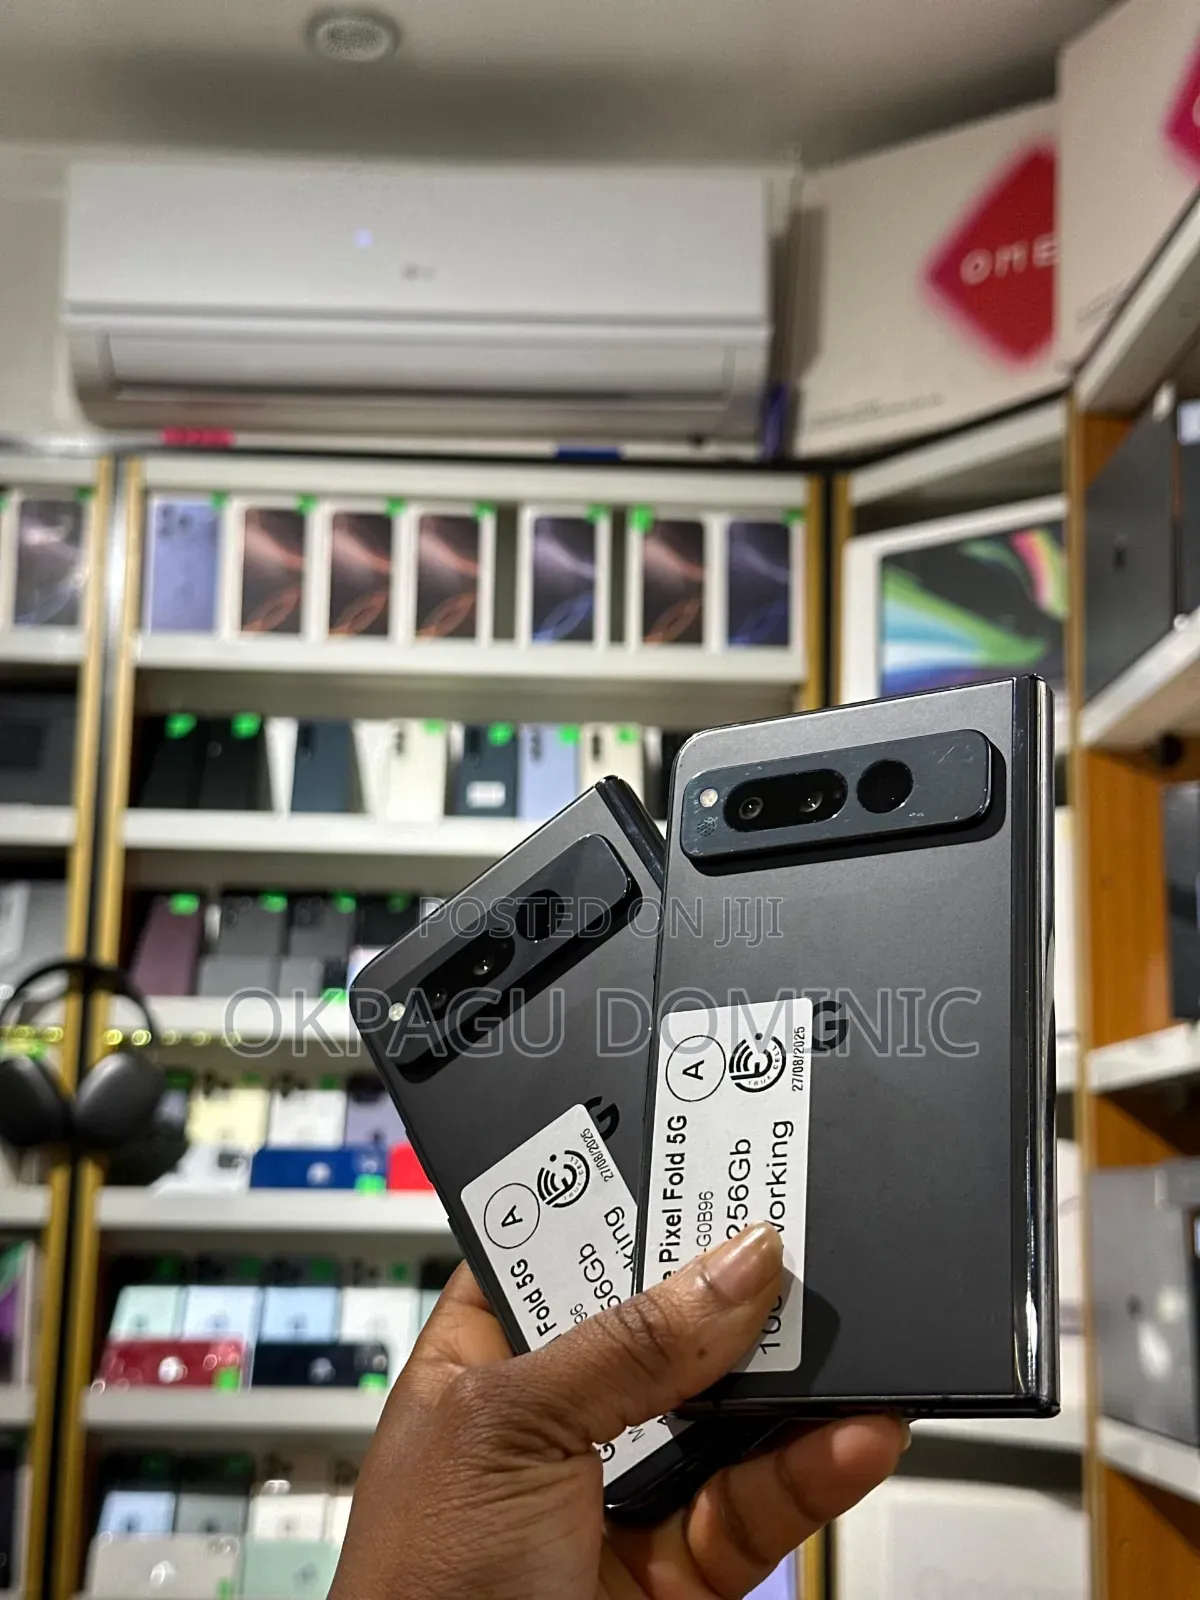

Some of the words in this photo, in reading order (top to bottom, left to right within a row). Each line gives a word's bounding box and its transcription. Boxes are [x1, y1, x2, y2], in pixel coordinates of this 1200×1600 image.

[682, 1060, 705, 1080] A
[791, 1026, 805, 1092] 27/08/2025
[667, 1115, 687, 1144] 5G
[579, 1127, 615, 1182] 27/08/2025
[663, 1153, 685, 1201] Fold
[501, 1205, 523, 1228] A
[659, 1208, 682, 1263] Pixel
[696, 1191, 713, 1253] -G0B96
[510, 1258, 534, 1290] 5G
[523, 1288, 557, 1337] Fold
